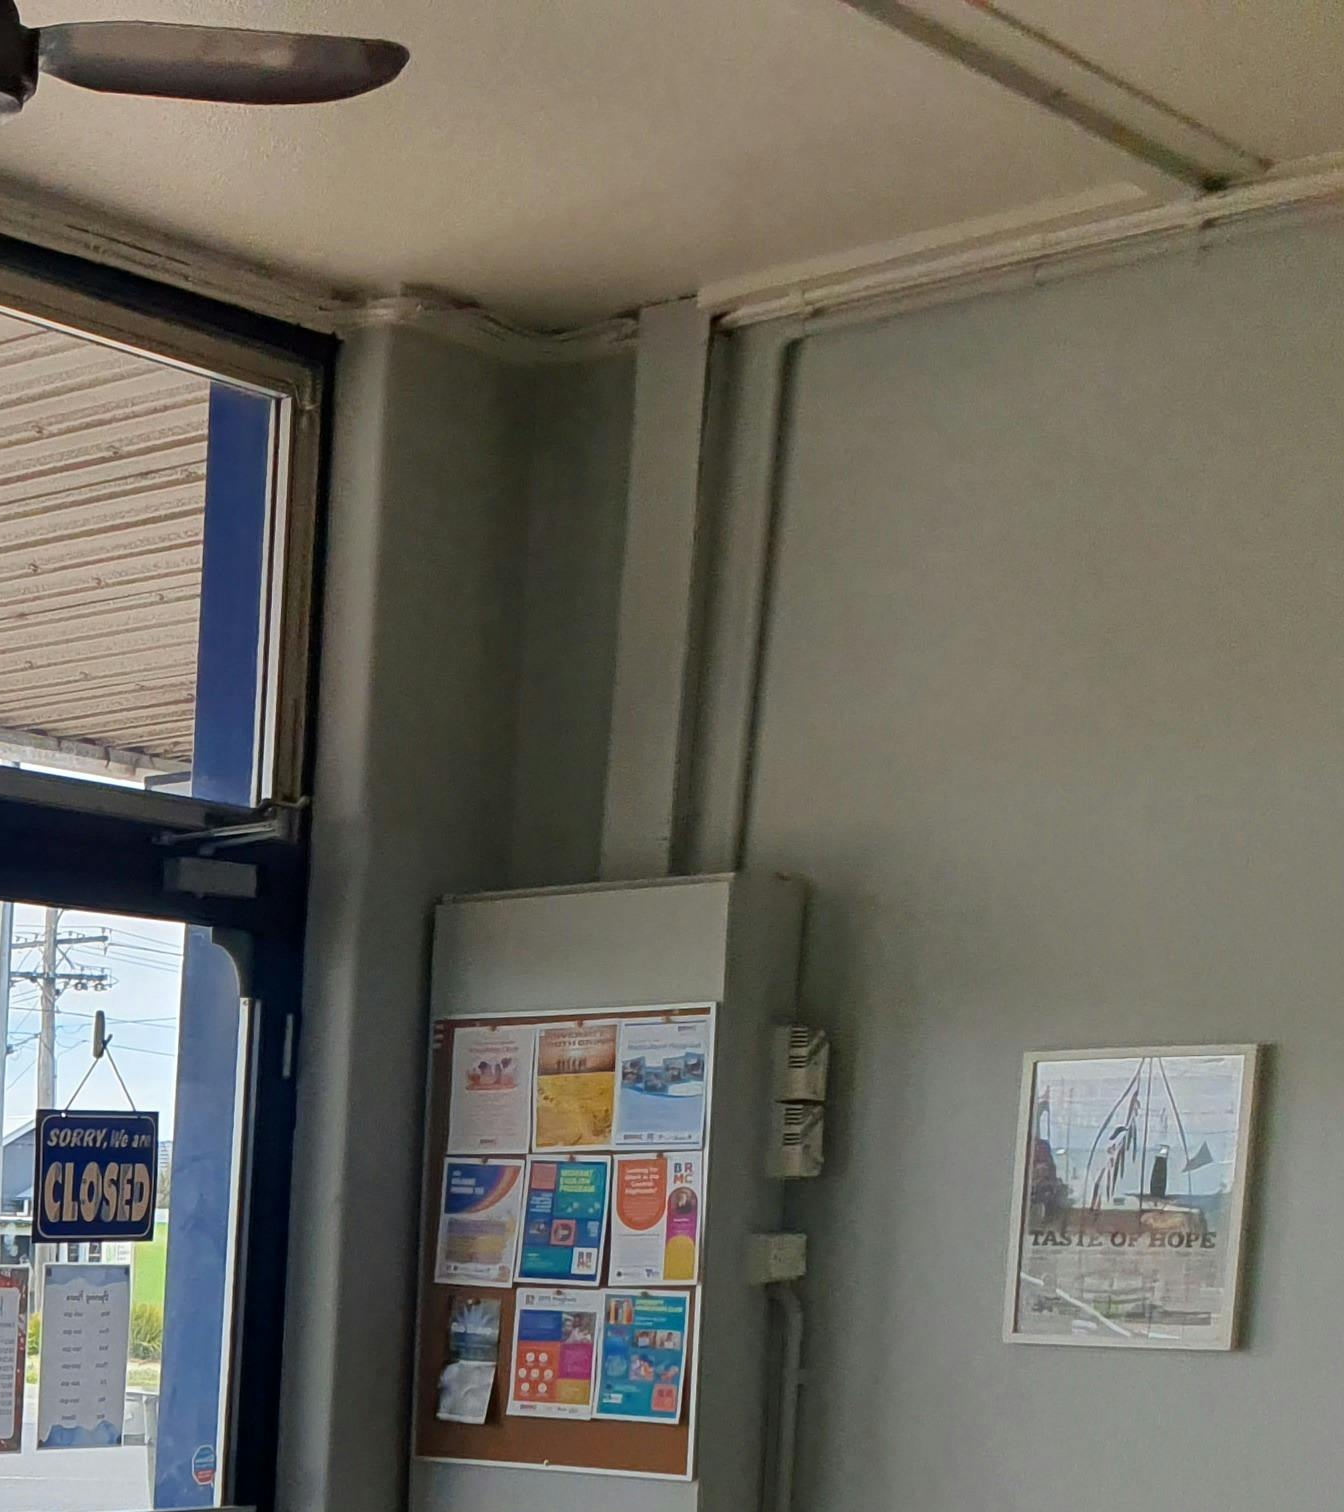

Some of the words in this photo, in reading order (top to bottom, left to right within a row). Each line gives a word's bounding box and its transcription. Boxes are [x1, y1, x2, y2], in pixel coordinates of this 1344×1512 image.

[47, 1127, 109, 1149] SORRY,
[44, 1161, 151, 1223] CLOSED
[1029, 1229, 1104, 1247] TASTE
[1109, 1231, 1140, 1247] OF
[1148, 1231, 1217, 1249] HOPE
